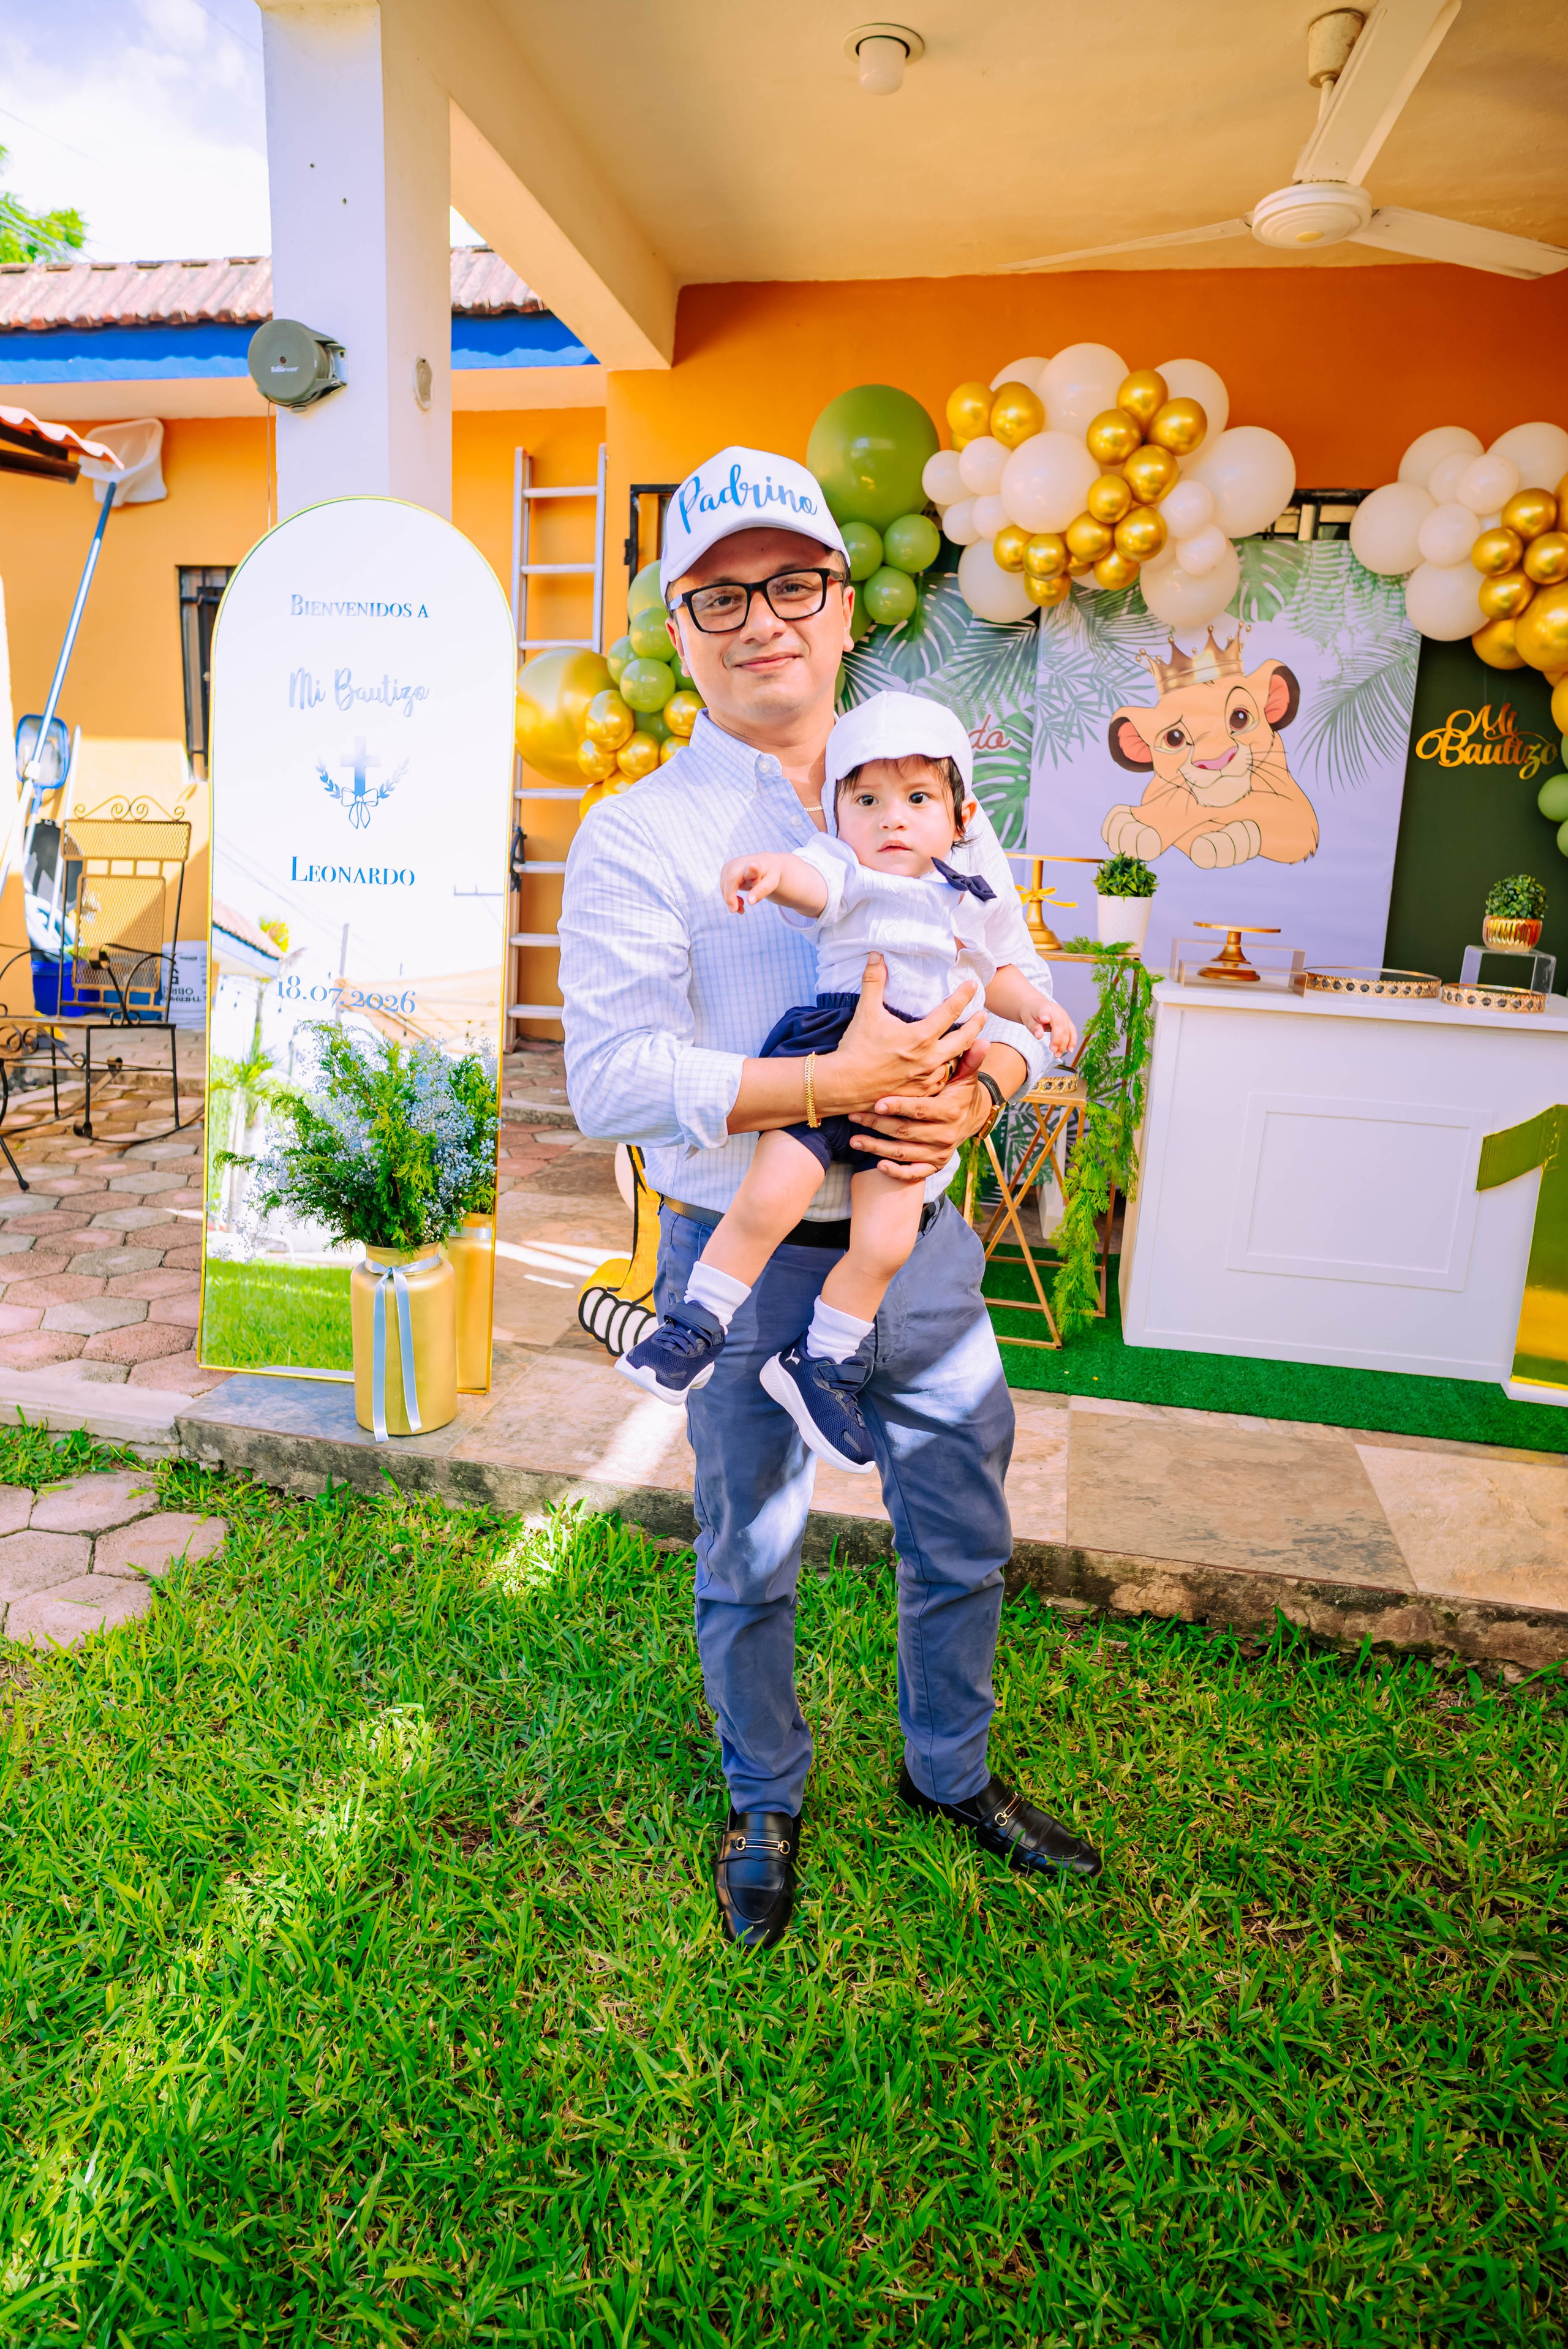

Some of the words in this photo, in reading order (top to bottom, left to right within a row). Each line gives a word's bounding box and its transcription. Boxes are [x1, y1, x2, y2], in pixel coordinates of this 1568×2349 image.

[679, 464, 818, 535] Padrino
[290, 594, 412, 618] BIENVENIDOS
[288, 666, 326, 710] Mi
[334, 667, 430, 717] Bautizo
[1446, 702, 1518, 739] Mi
[1415, 727, 1558, 780] Bautizo
[290, 856, 415, 886] LEONARDO
[277, 975, 417, 1014] 18.07.2026
